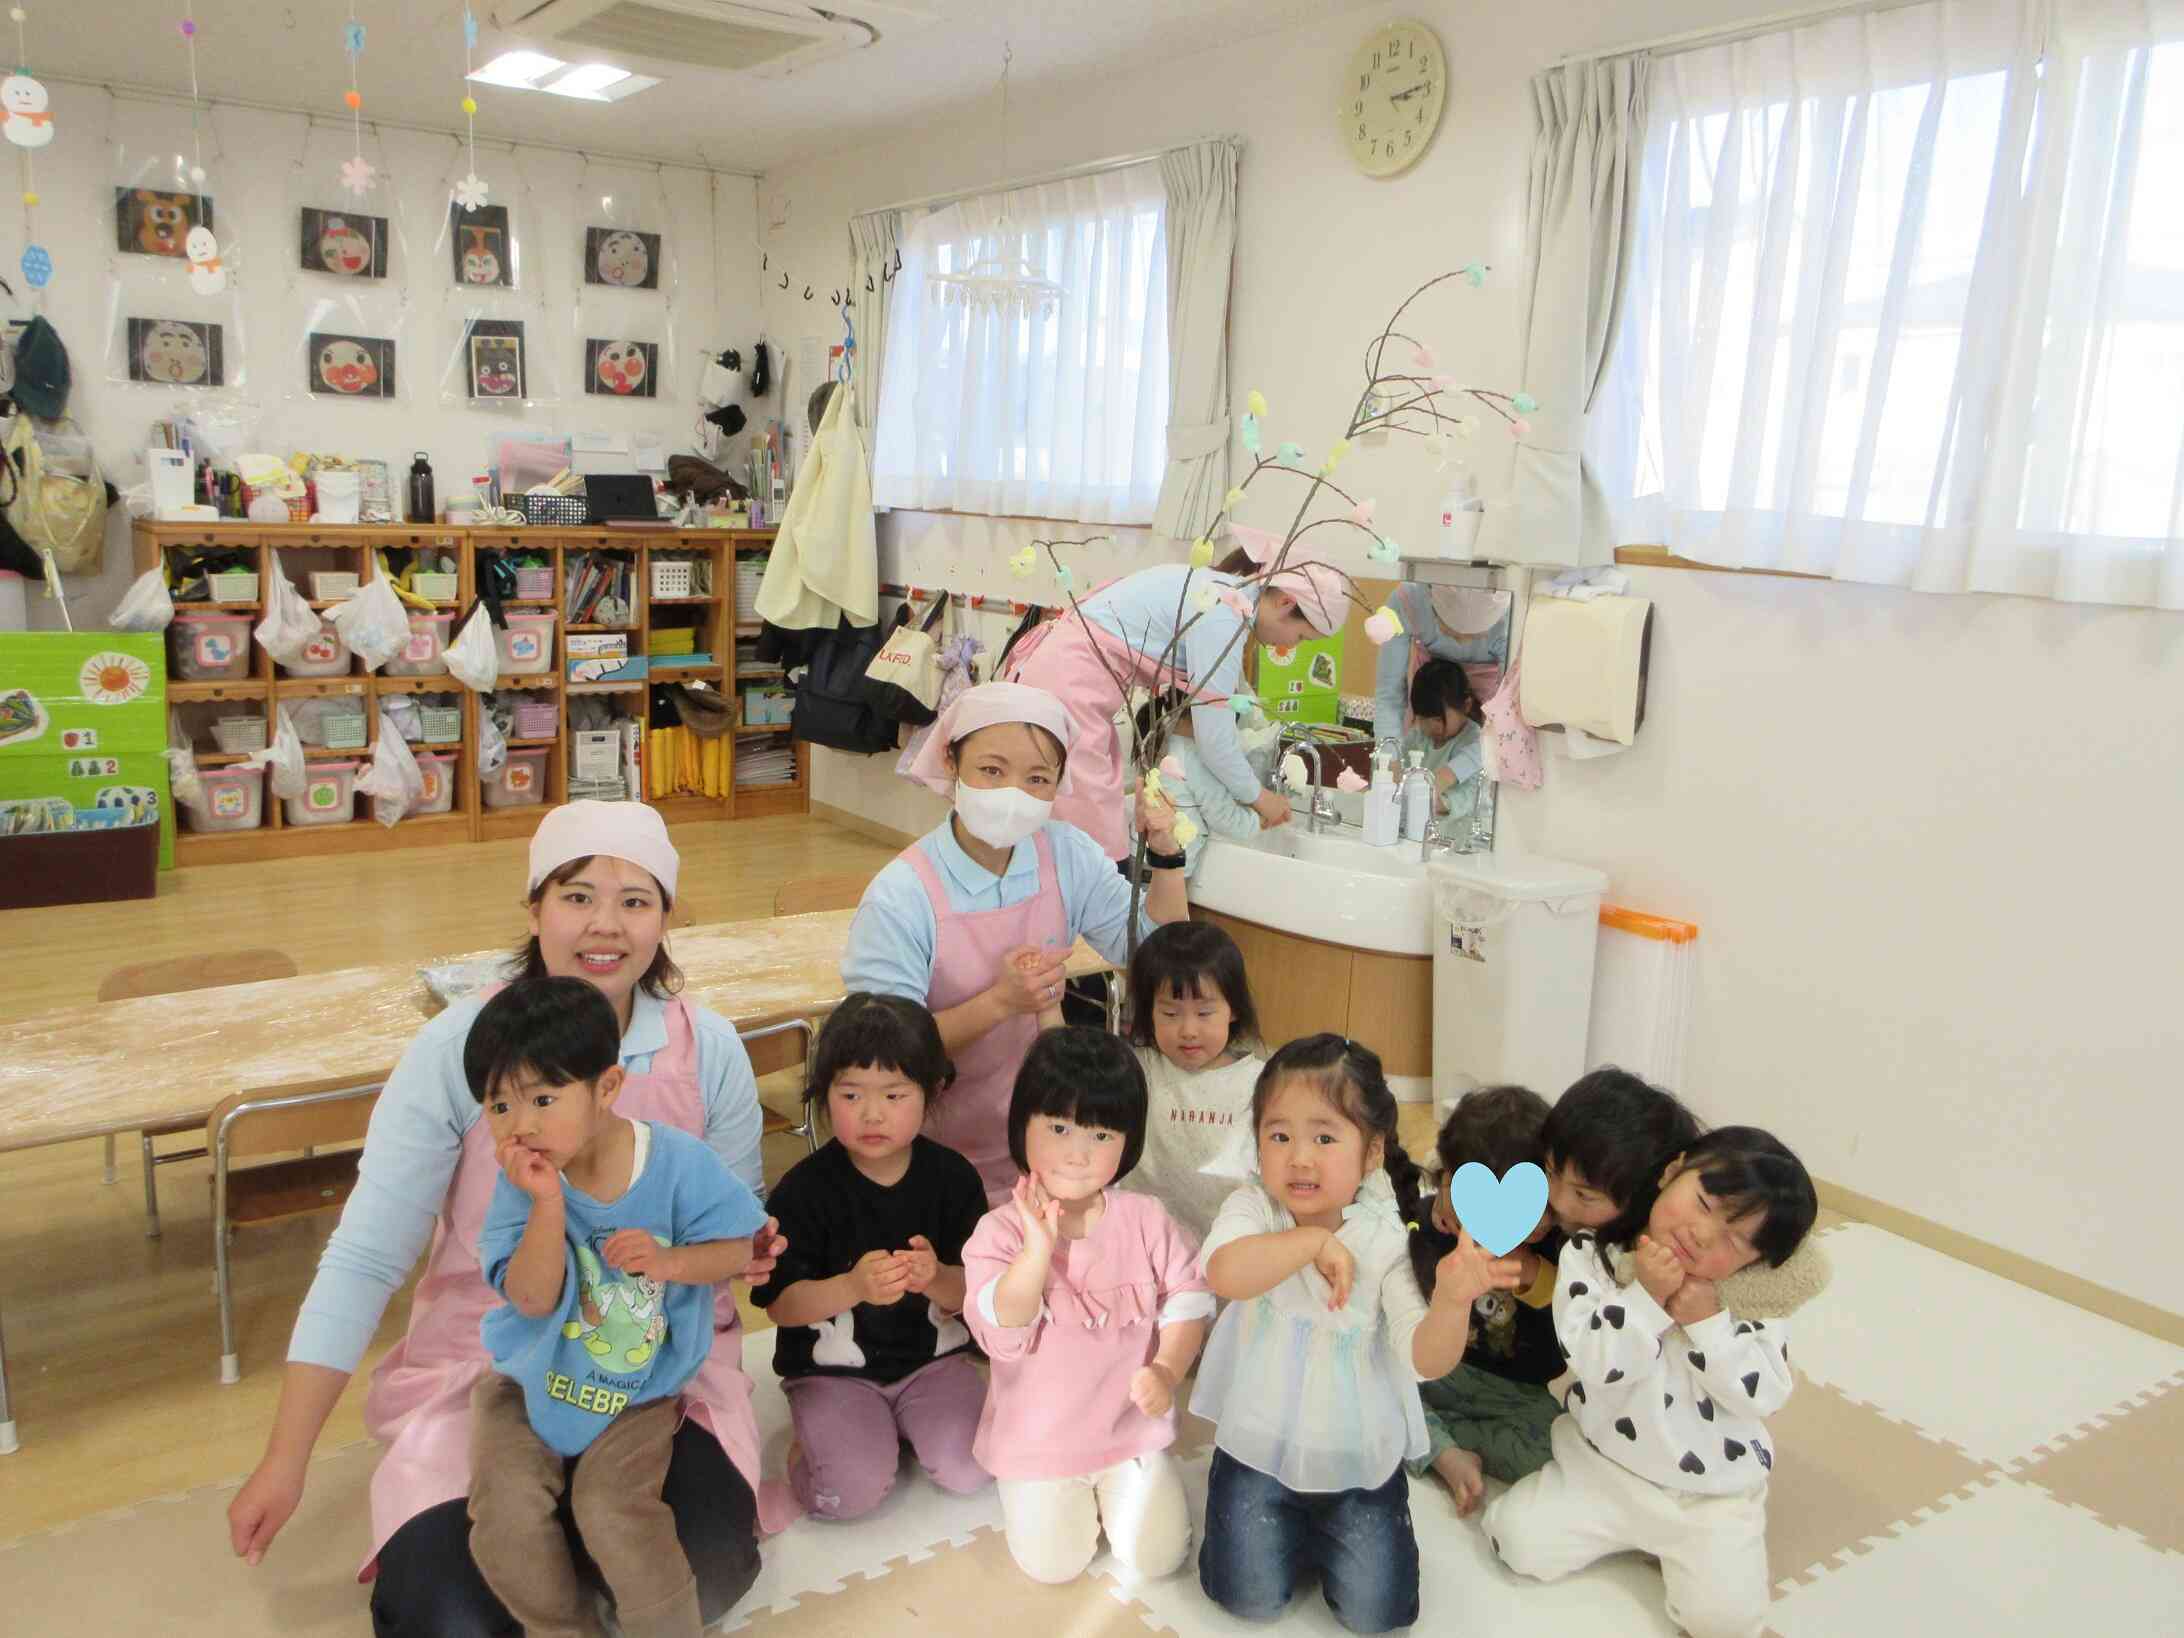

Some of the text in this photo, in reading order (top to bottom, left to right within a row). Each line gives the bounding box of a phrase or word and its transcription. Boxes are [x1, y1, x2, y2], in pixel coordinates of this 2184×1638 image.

[1388, 39, 1400, 57] 12
[1408, 39, 1414, 59] 1
[1372, 53, 1381, 70] 11
[1419, 56, 1428, 74] 2
[1359, 73, 1370, 91] 10
[1423, 79, 1432, 97] 3
[1354, 100, 1363, 117] 9
[1416, 106, 1424, 124] 4
[1357, 122, 1367, 140] 8
[1404, 129, 1412, 146] 5
[1370, 138, 1378, 155] 7
[1385, 141, 1394, 157] 6
[83, 731, 95, 745] 1
[104, 760, 117, 774] 2
[147, 791, 157, 805] 3
[1171, 1108, 1233, 1126] NARANJA
[586, 1369, 596, 1383] A
